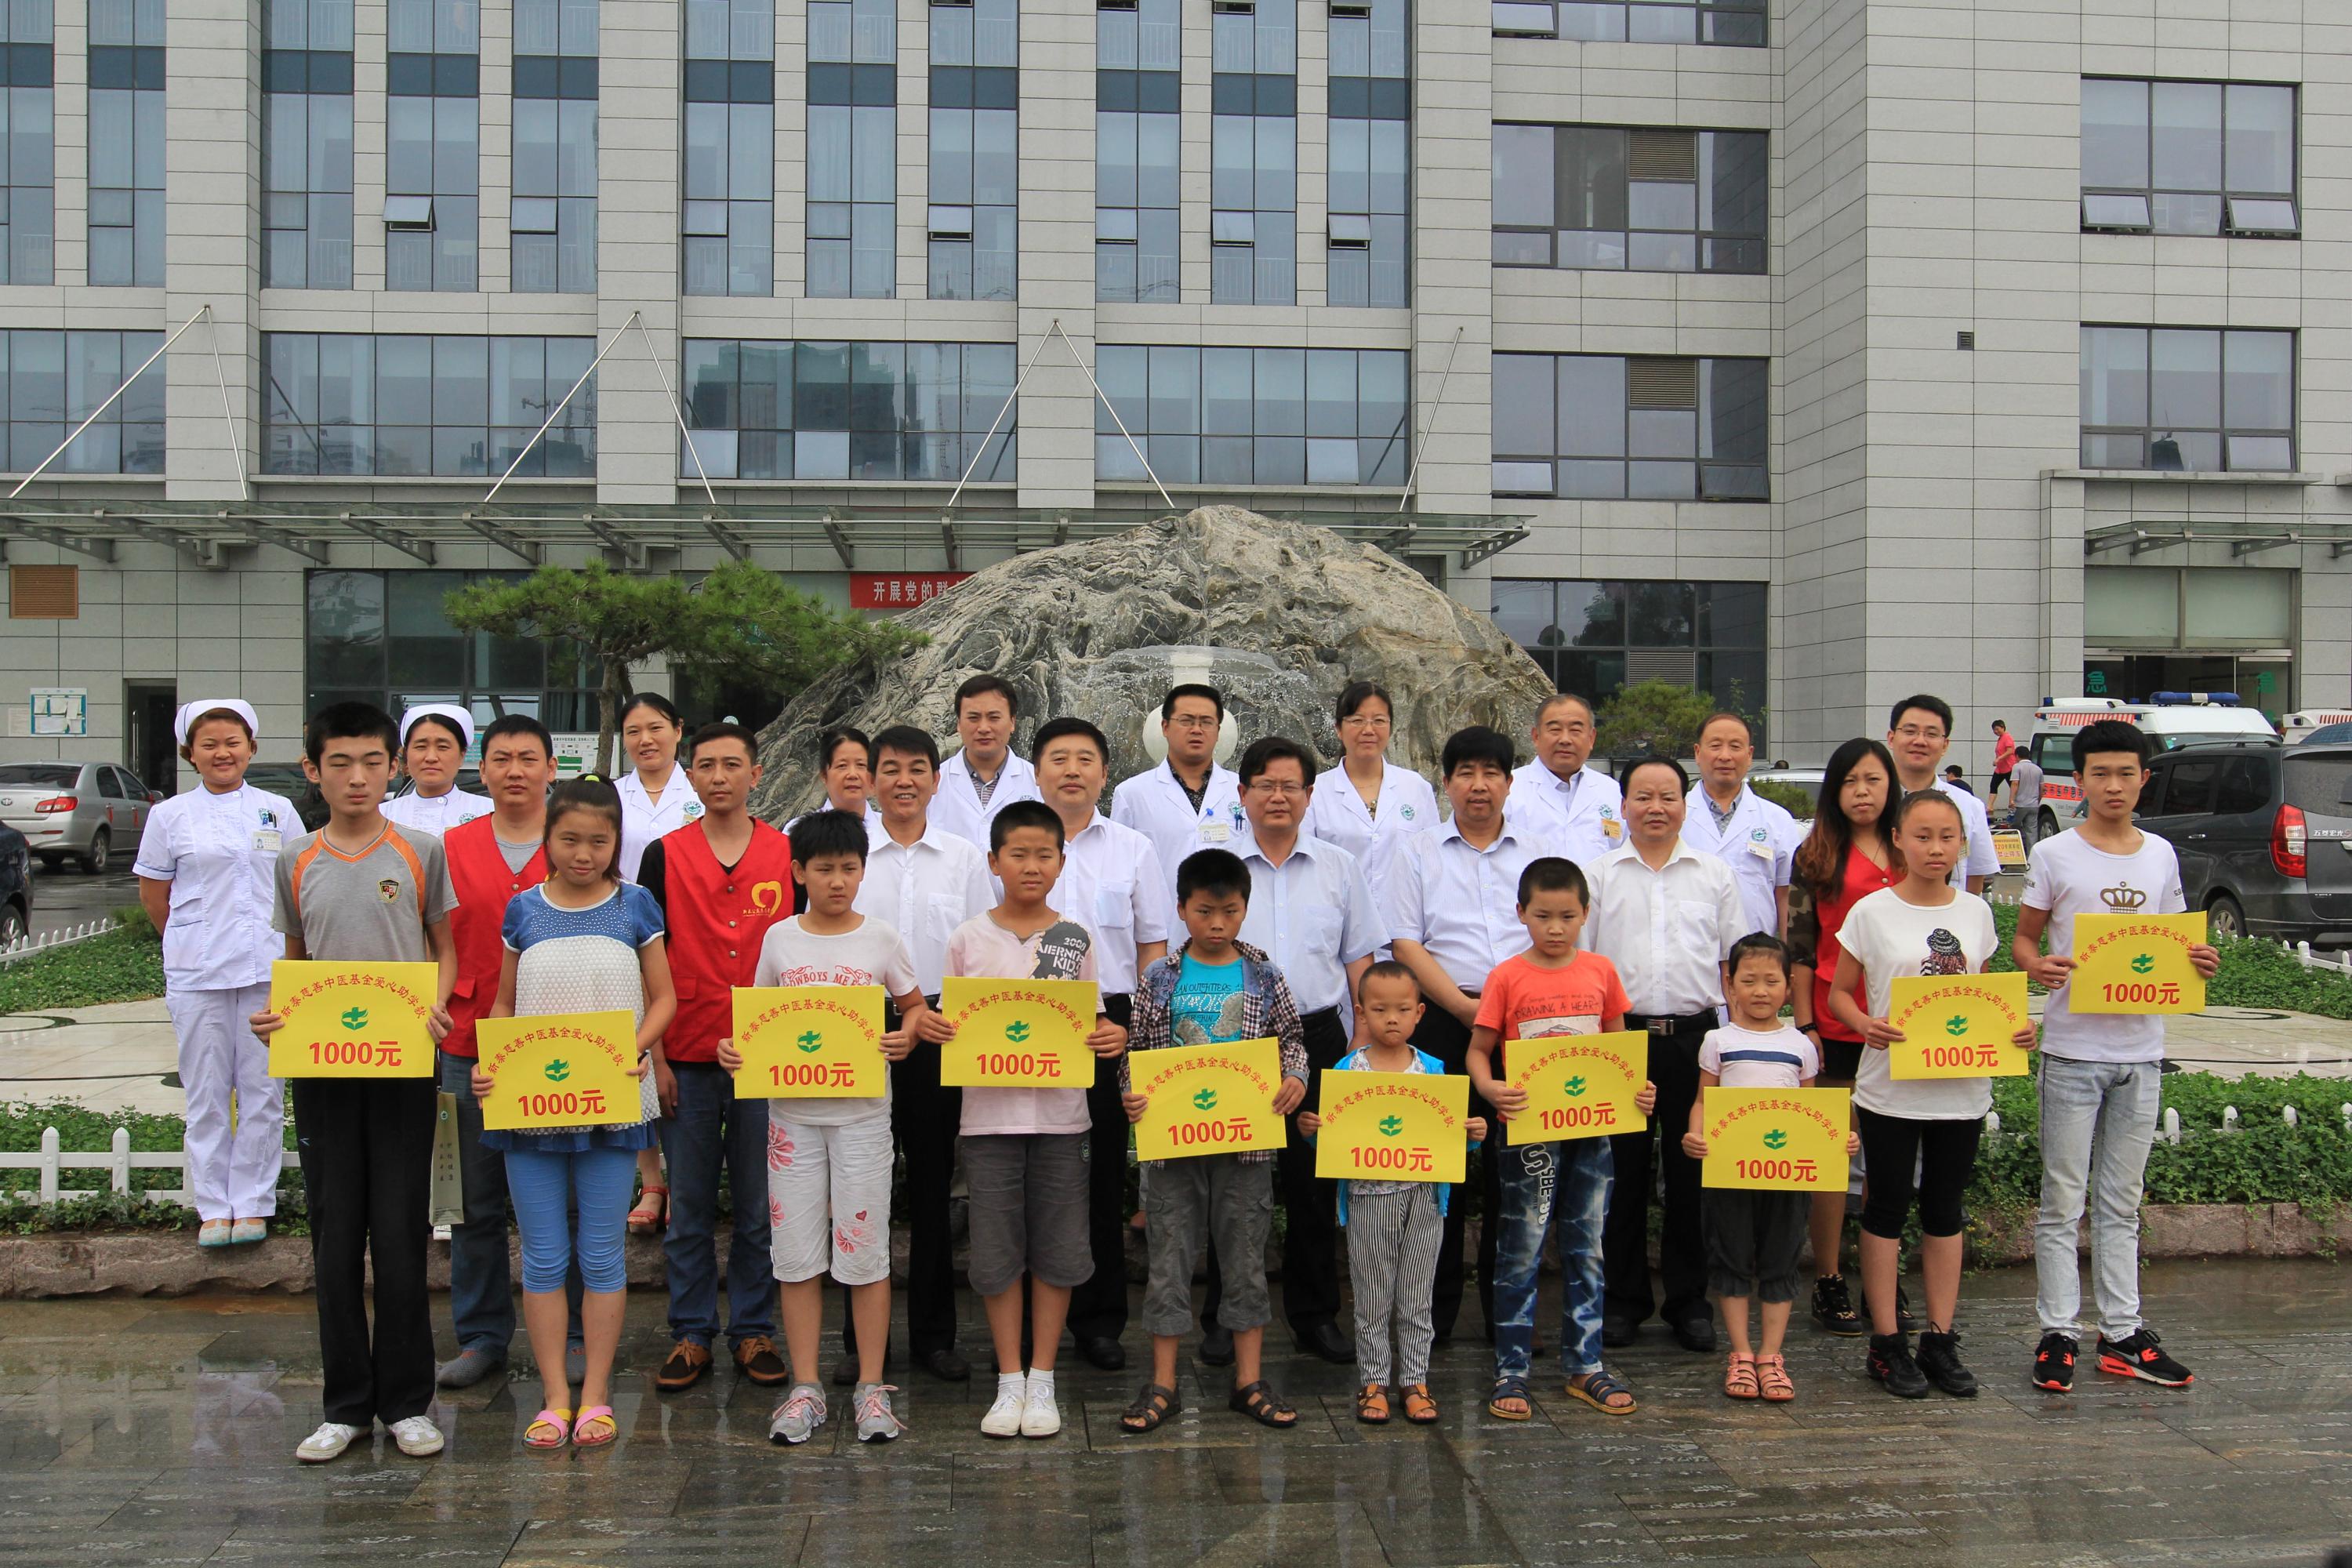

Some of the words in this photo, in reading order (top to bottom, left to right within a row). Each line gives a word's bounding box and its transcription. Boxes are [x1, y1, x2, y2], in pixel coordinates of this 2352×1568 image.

[873, 580, 960, 602] 开展党的群
[2086, 670, 2107, 694] 急
[281, 973, 428, 1019] 新泰慈善中医基金爱心助学款
[1896, 986, 2017, 1028] 新泰慈善中医基金爱心助学款
[2101, 982, 2181, 1006] 1000元
[741, 998, 877, 1043] 新泰慈善中医基金爱心助学款
[1514, 1002, 1555, 1019] DRAWING
[1560, 1002, 1566, 1011] A
[308, 1040, 403, 1068] 1000元
[488, 1026, 626, 1074] 新泰慈善中医基金爱心助学款
[1922, 1044, 2000, 1068] 1000元
[769, 1062, 855, 1087] 1000元
[976, 1053, 1062, 1078] 1000元
[1143, 1057, 1271, 1099] 泰慈善中医基金爱心助学款
[517, 1089, 608, 1118] 1000元
[1326, 1085, 1456, 1127] 新泰慈善中医基金爱心助学款
[1539, 1102, 1617, 1131] 1000元
[1167, 1117, 1254, 1147] 1000元
[1711, 1099, 1839, 1141] 新泰慈善中医基金爱心助学款
[1350, 1146, 1434, 1173] 1000元
[1736, 1159, 1819, 1182] 1000元
